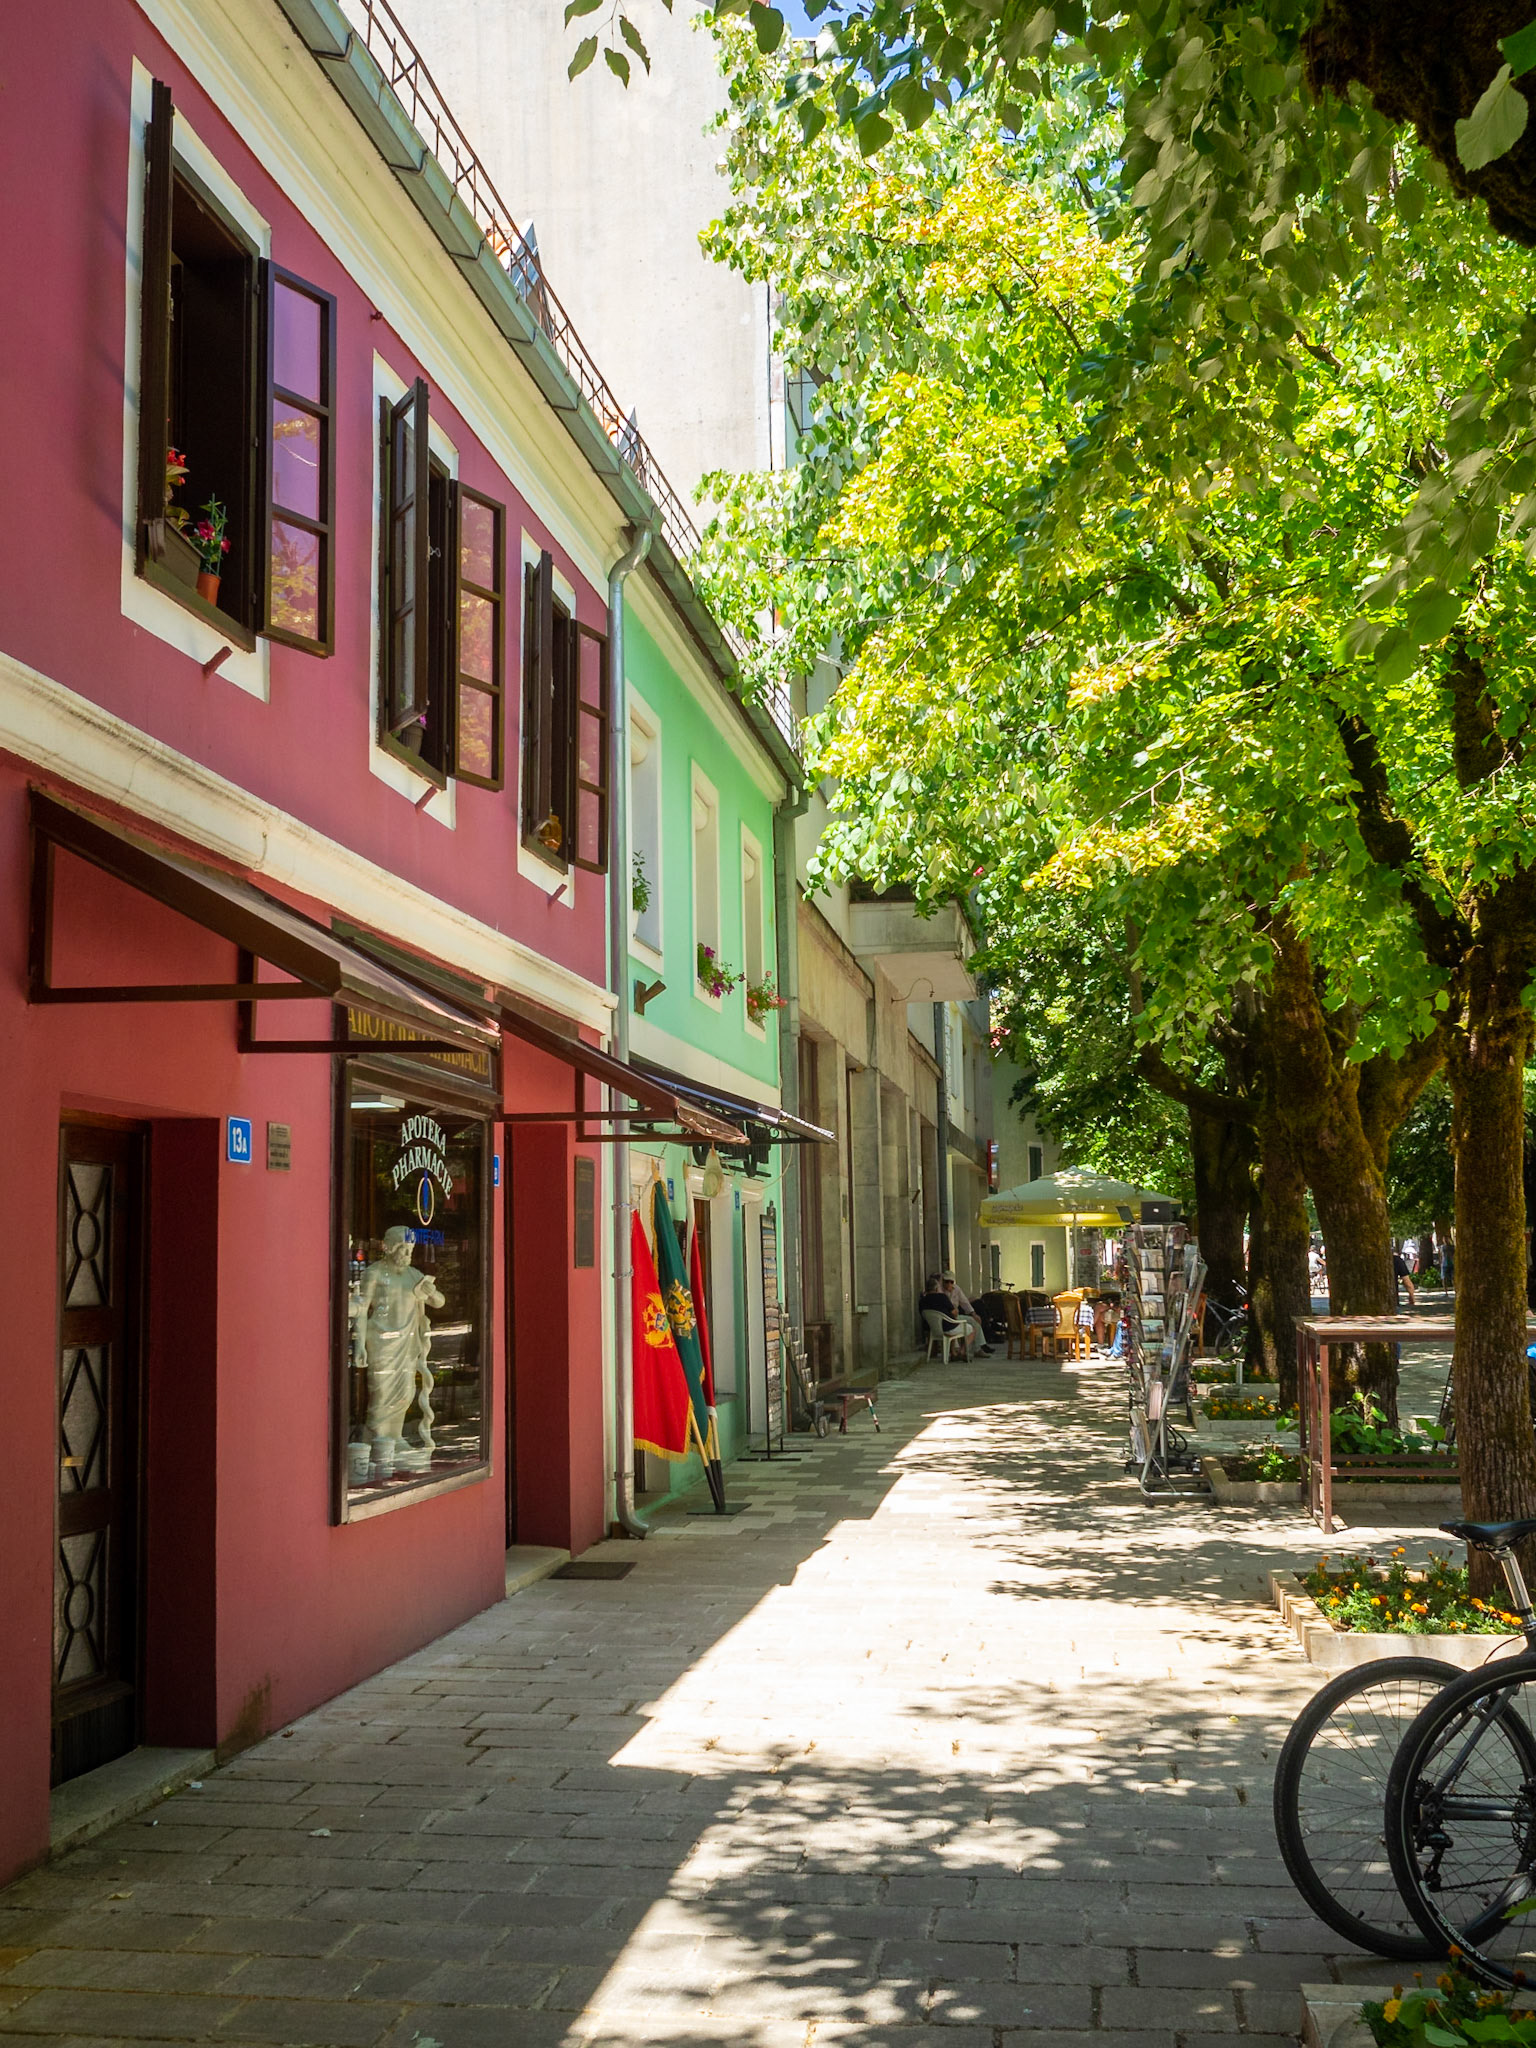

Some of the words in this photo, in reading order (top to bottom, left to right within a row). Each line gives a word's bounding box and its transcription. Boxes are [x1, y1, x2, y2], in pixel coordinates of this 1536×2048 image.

[232, 1126, 248, 1154] 13A
[401, 1115, 447, 1157] APOTEKA
[392, 1146, 454, 1200] PHARMACIE
